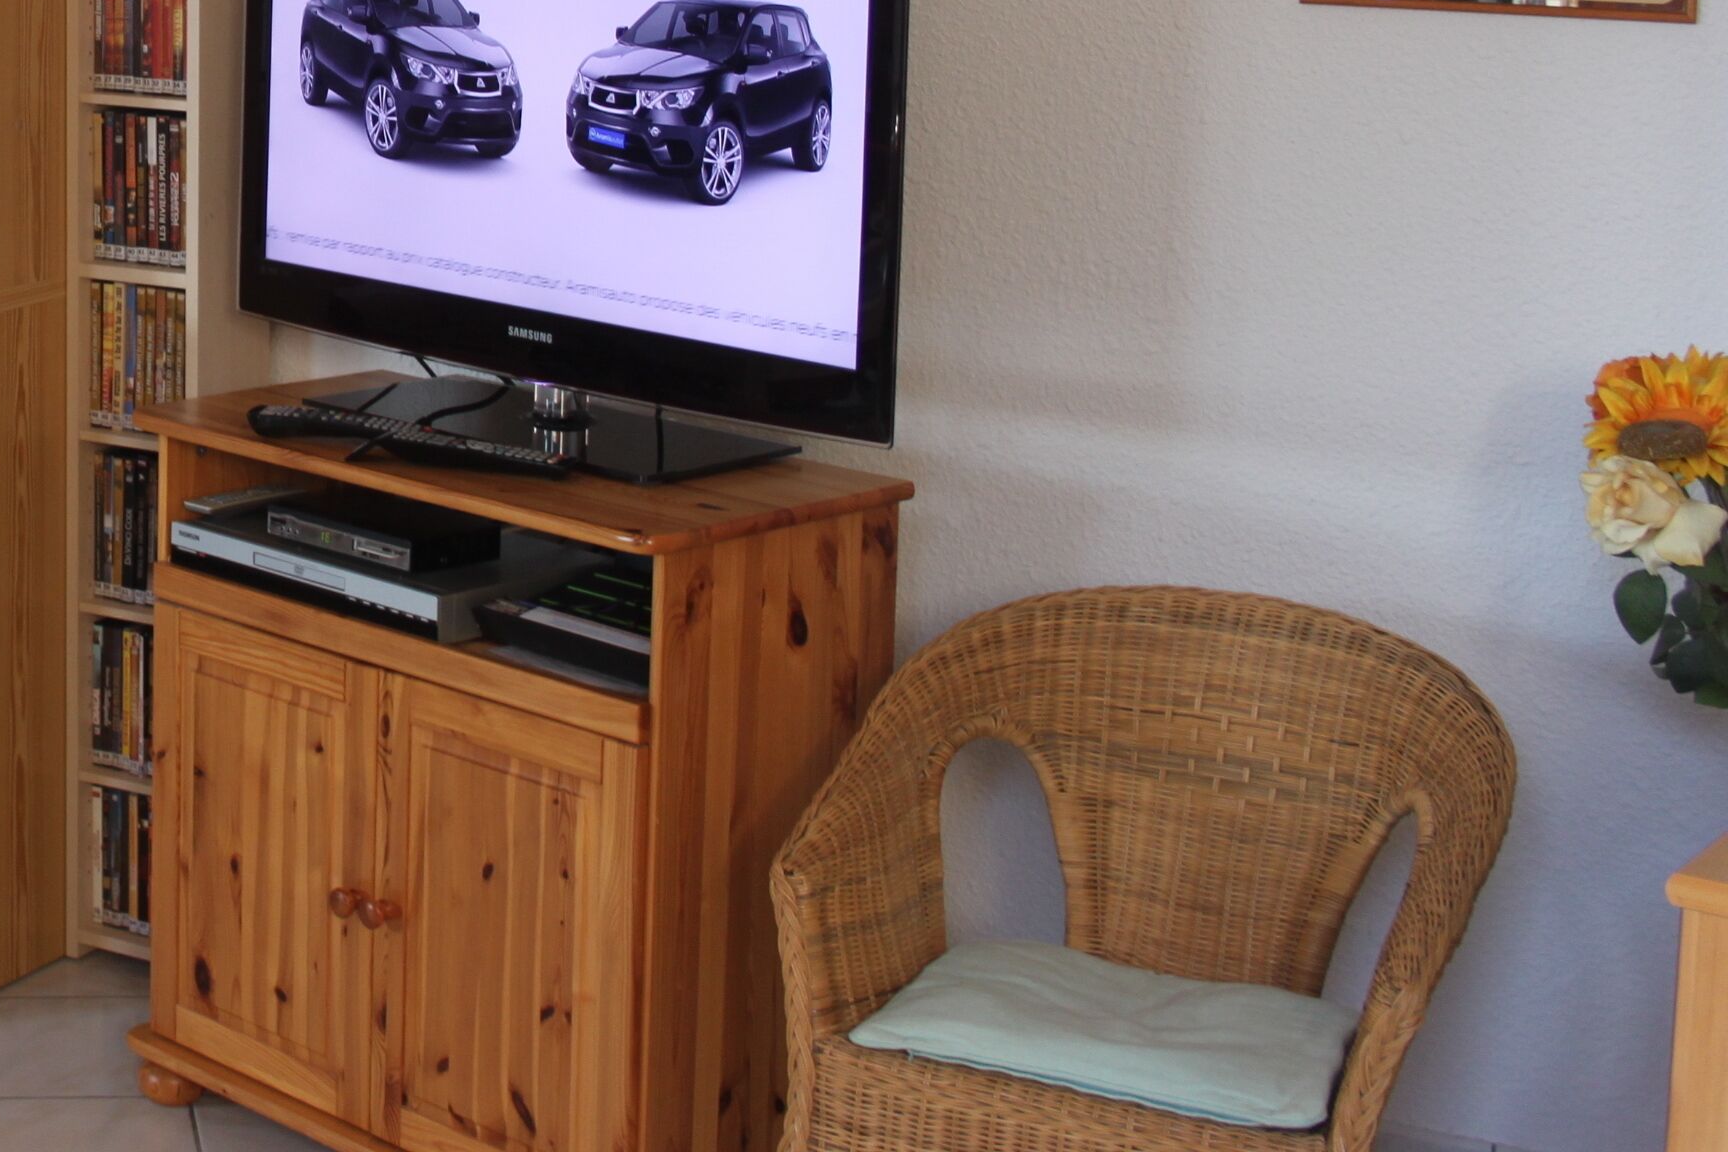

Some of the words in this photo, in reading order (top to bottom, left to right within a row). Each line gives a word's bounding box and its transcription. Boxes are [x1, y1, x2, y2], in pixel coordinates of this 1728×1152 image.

[158, 133, 166, 181] POURPRES
[170, 172, 180, 182] 2
[158, 224, 166, 241] LES
[342, 241, 383, 258] rapport
[425, 255, 483, 276] catalogue
[565, 279, 636, 304] Aramisauto
[638, 295, 693, 315] propose
[695, 304, 720, 319] des
[788, 321, 827, 339] neufs
[829, 330, 849, 342] en
[508, 325, 553, 344] SAMSUNG
[124, 508, 133, 530] CODE
[124, 531, 133, 553] VINCI
